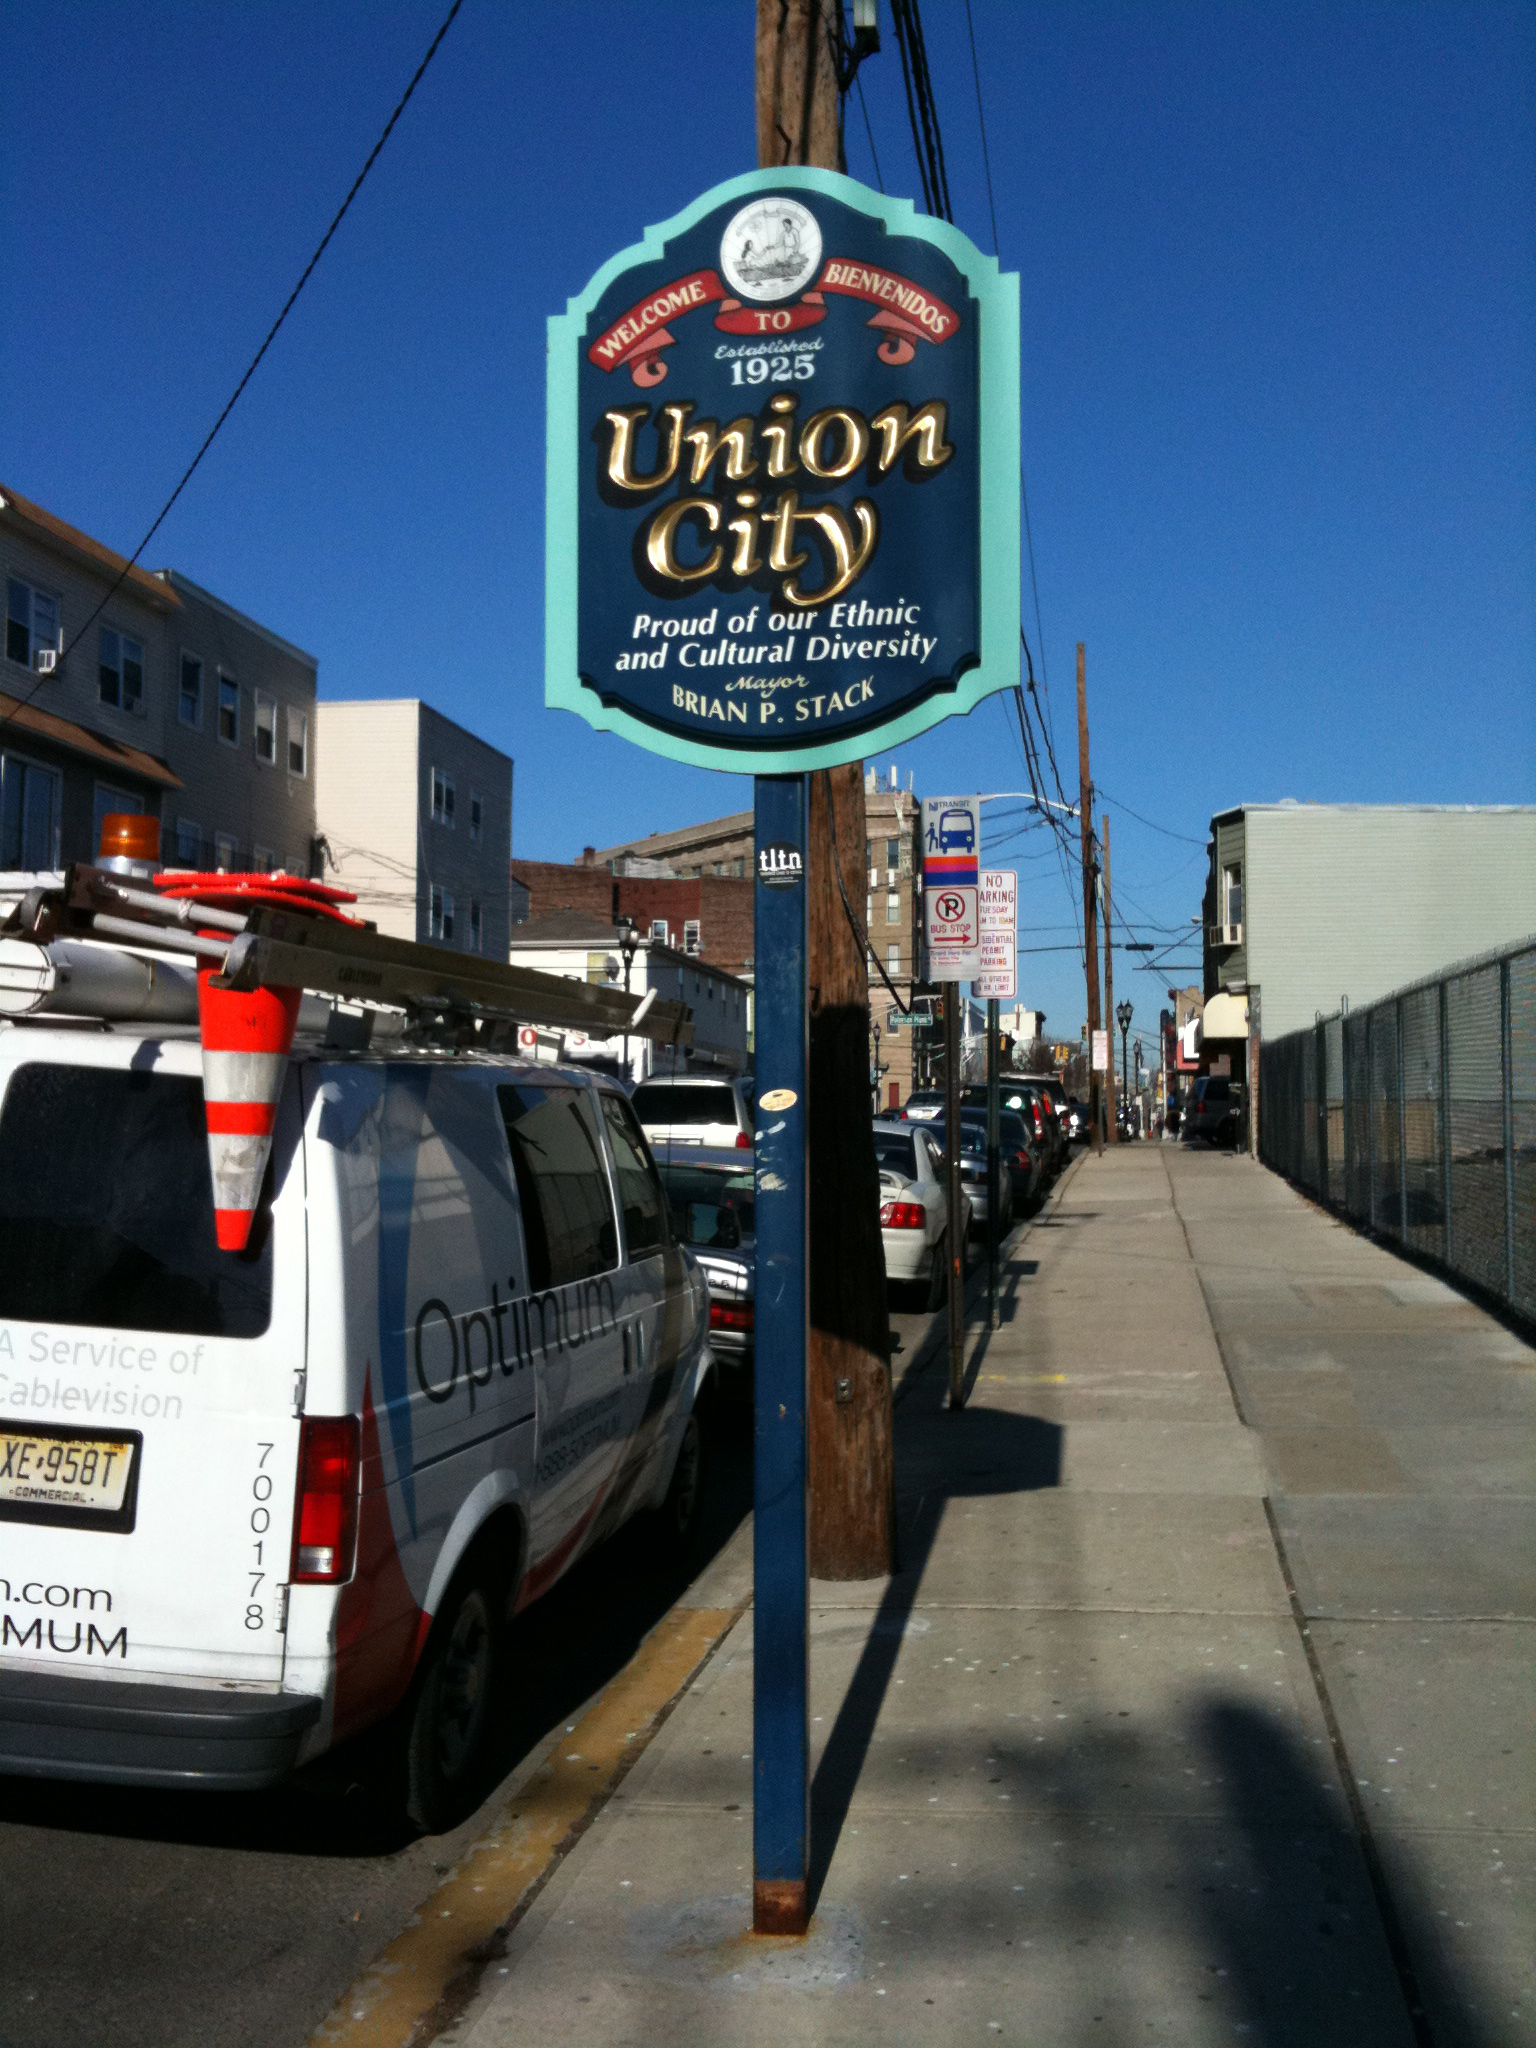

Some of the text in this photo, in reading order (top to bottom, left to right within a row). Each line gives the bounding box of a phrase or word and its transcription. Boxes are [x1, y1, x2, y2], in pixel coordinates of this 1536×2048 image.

[824, 262, 950, 334] BIENVENIDOS
[597, 281, 706, 360] WELCOME
[754, 311, 791, 331] TO
[714, 337, 824, 360] Established
[730, 353, 816, 386] 1925
[605, 394, 953, 491] Union
[646, 489, 877, 606] City
[632, 598, 921, 639] Proud of our Ethnic
[615, 632, 938, 671] and Cultural Diversity
[672, 675, 875, 723] BRIAN P. STACK
[725, 673, 810, 698] Mayor
[980, 890, 1014, 903] ARKING
[986, 875, 1003, 887] NO
[931, 924, 971, 933] BUS STOP
[0, 1328, 205, 1375] A Service of
[415, 1276, 618, 1415] Optimum
[15, 1486, 87, 1503] COMMERCIAL
[0, 1578, 112, 1612] .com
